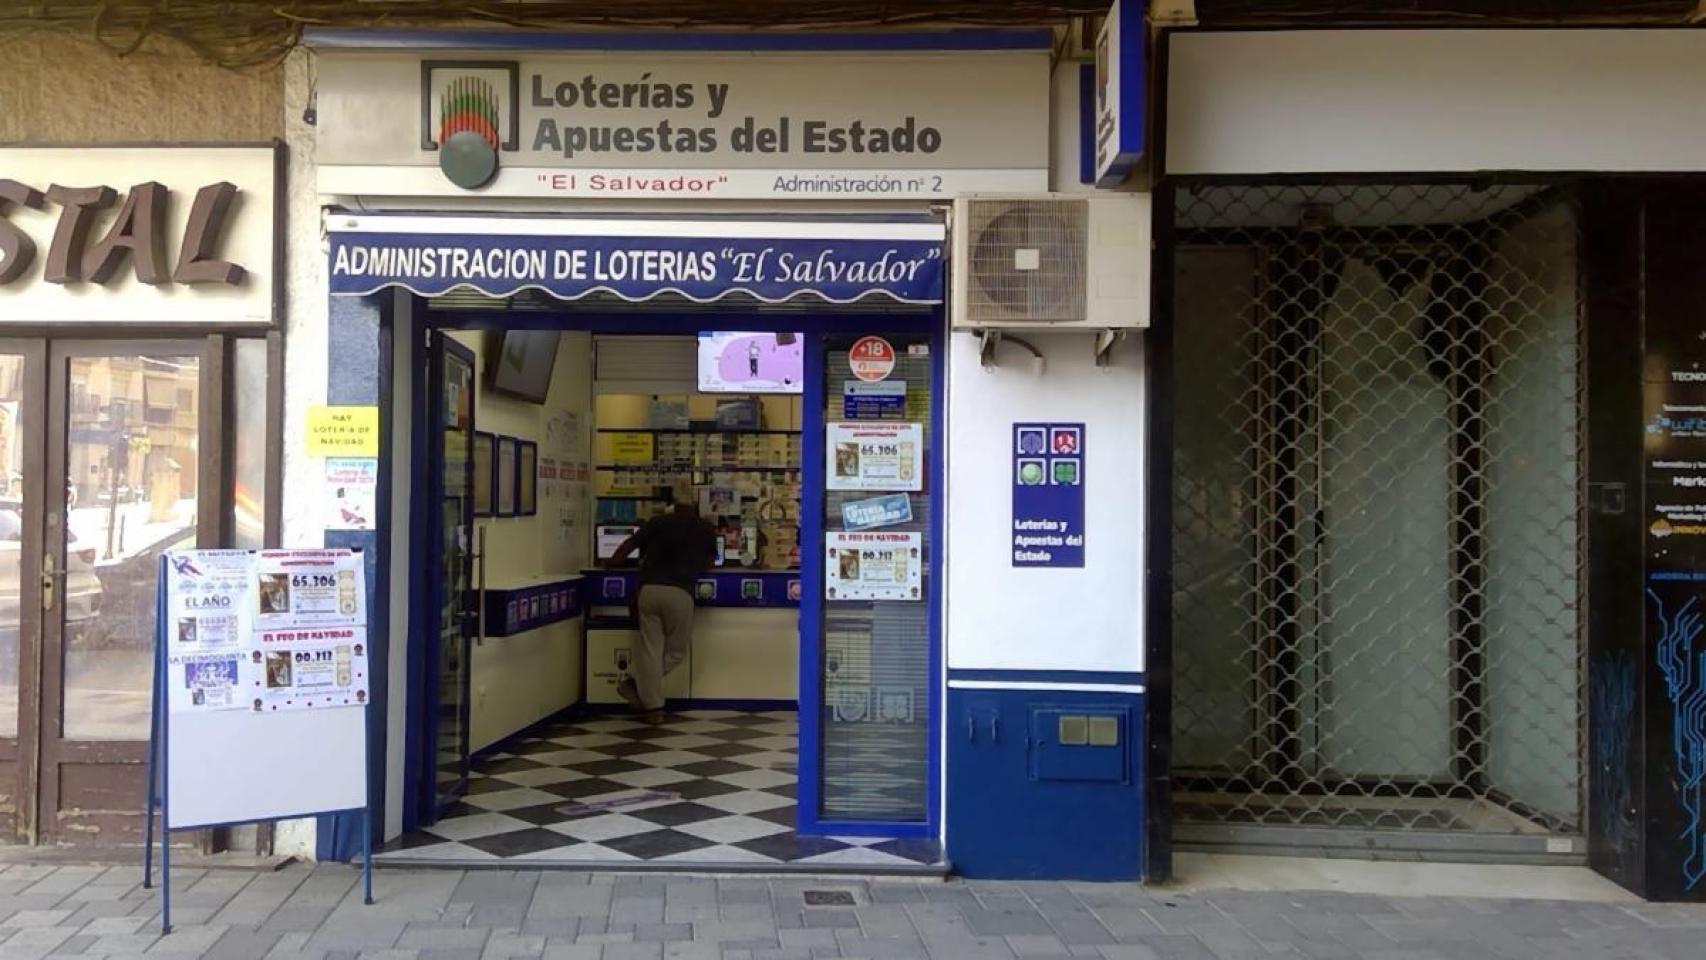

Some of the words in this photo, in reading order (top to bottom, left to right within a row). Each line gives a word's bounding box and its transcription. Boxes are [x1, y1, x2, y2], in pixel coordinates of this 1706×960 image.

[532, 72, 694, 108] Loterías
[707, 81, 729, 118] y
[532, 118, 716, 158] Apuestas
[731, 116, 789, 153] del
[802, 117, 942, 154] Estado
[537, 174, 576, 191] "El
[590, 174, 728, 191] Salvador"
[773, 175, 902, 193] Administración
[932, 176, 942, 193] 2
[333, 246, 547, 279] ADMINISTRACION
[553, 250, 586, 280] DE
[594, 249, 717, 282] LOTERIAS
[859, 342, 884, 356] +18
[1014, 535, 1063, 548] Apuestas
[1066, 535, 1083, 546] del
[1014, 550, 1051, 561] Estado
[185, 597, 199, 607] EL
[202, 594, 231, 607] AÑO
